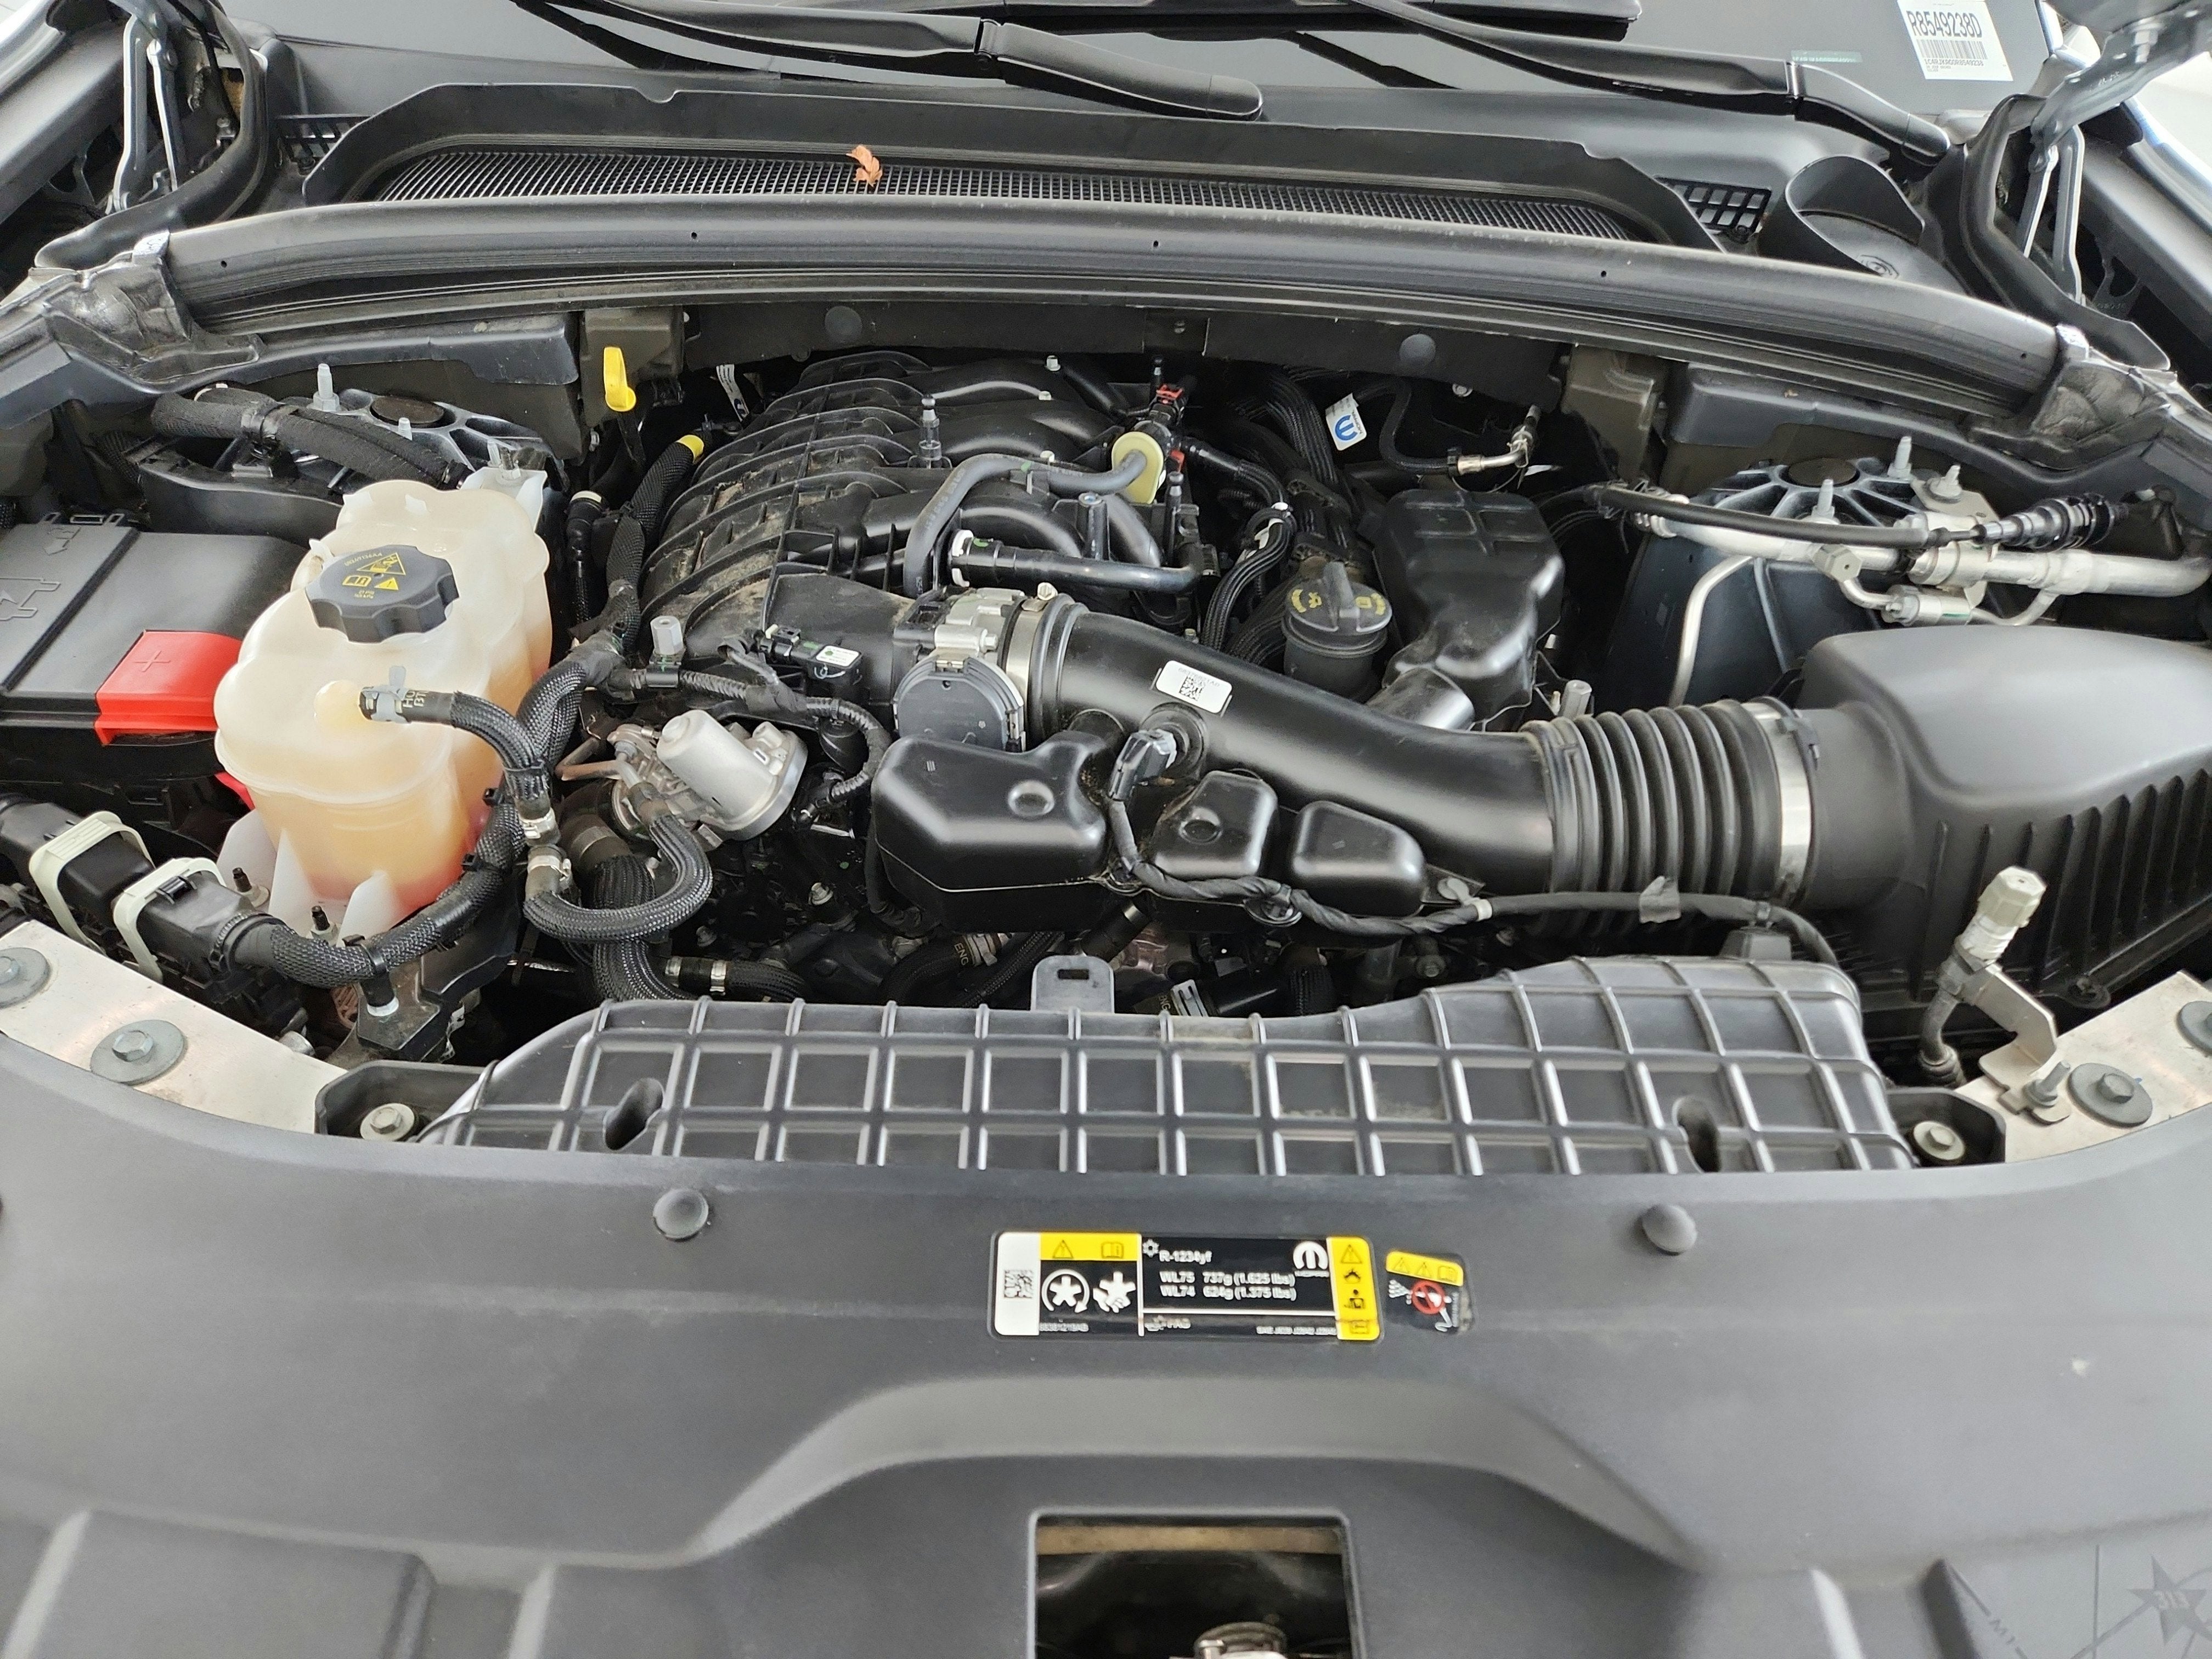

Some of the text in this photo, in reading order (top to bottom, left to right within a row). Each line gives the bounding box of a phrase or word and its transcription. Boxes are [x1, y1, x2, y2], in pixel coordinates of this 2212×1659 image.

[1906, 10, 1982, 37] R8549238D
[954, 943, 968, 966] ENG
[1159, 1249, 1212, 1265] R-1234yf
[1159, 1271, 1195, 1283] WL75
[1202, 1271, 1233, 1286] 737g
[1233, 1272, 1271, 1286] (1.625
[1271, 1272, 1296, 1287] lbs)
[1160, 1285, 1297, 1301] WL74 624g (1.375 lbs)
